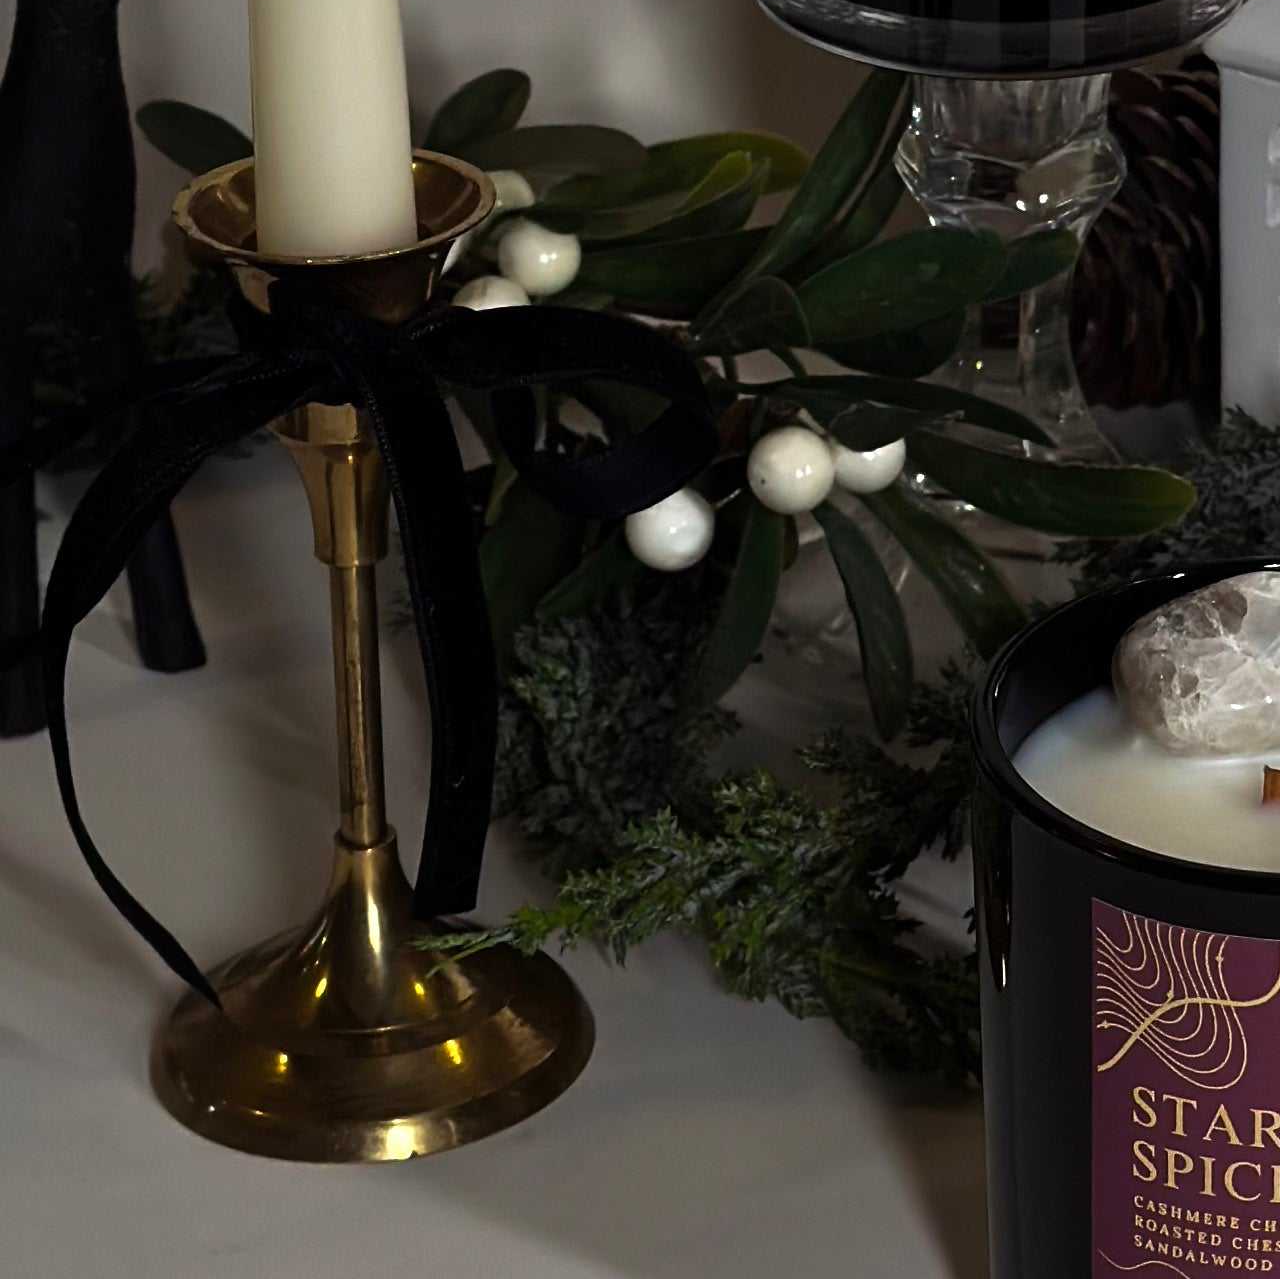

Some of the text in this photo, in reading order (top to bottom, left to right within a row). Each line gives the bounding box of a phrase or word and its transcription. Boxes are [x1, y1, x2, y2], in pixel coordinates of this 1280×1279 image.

[1134, 1195, 1240, 1229] CASHMERE
[1134, 1215, 1223, 1247] ROASTED
[1133, 1234, 1273, 1271] SANDALWOOD
